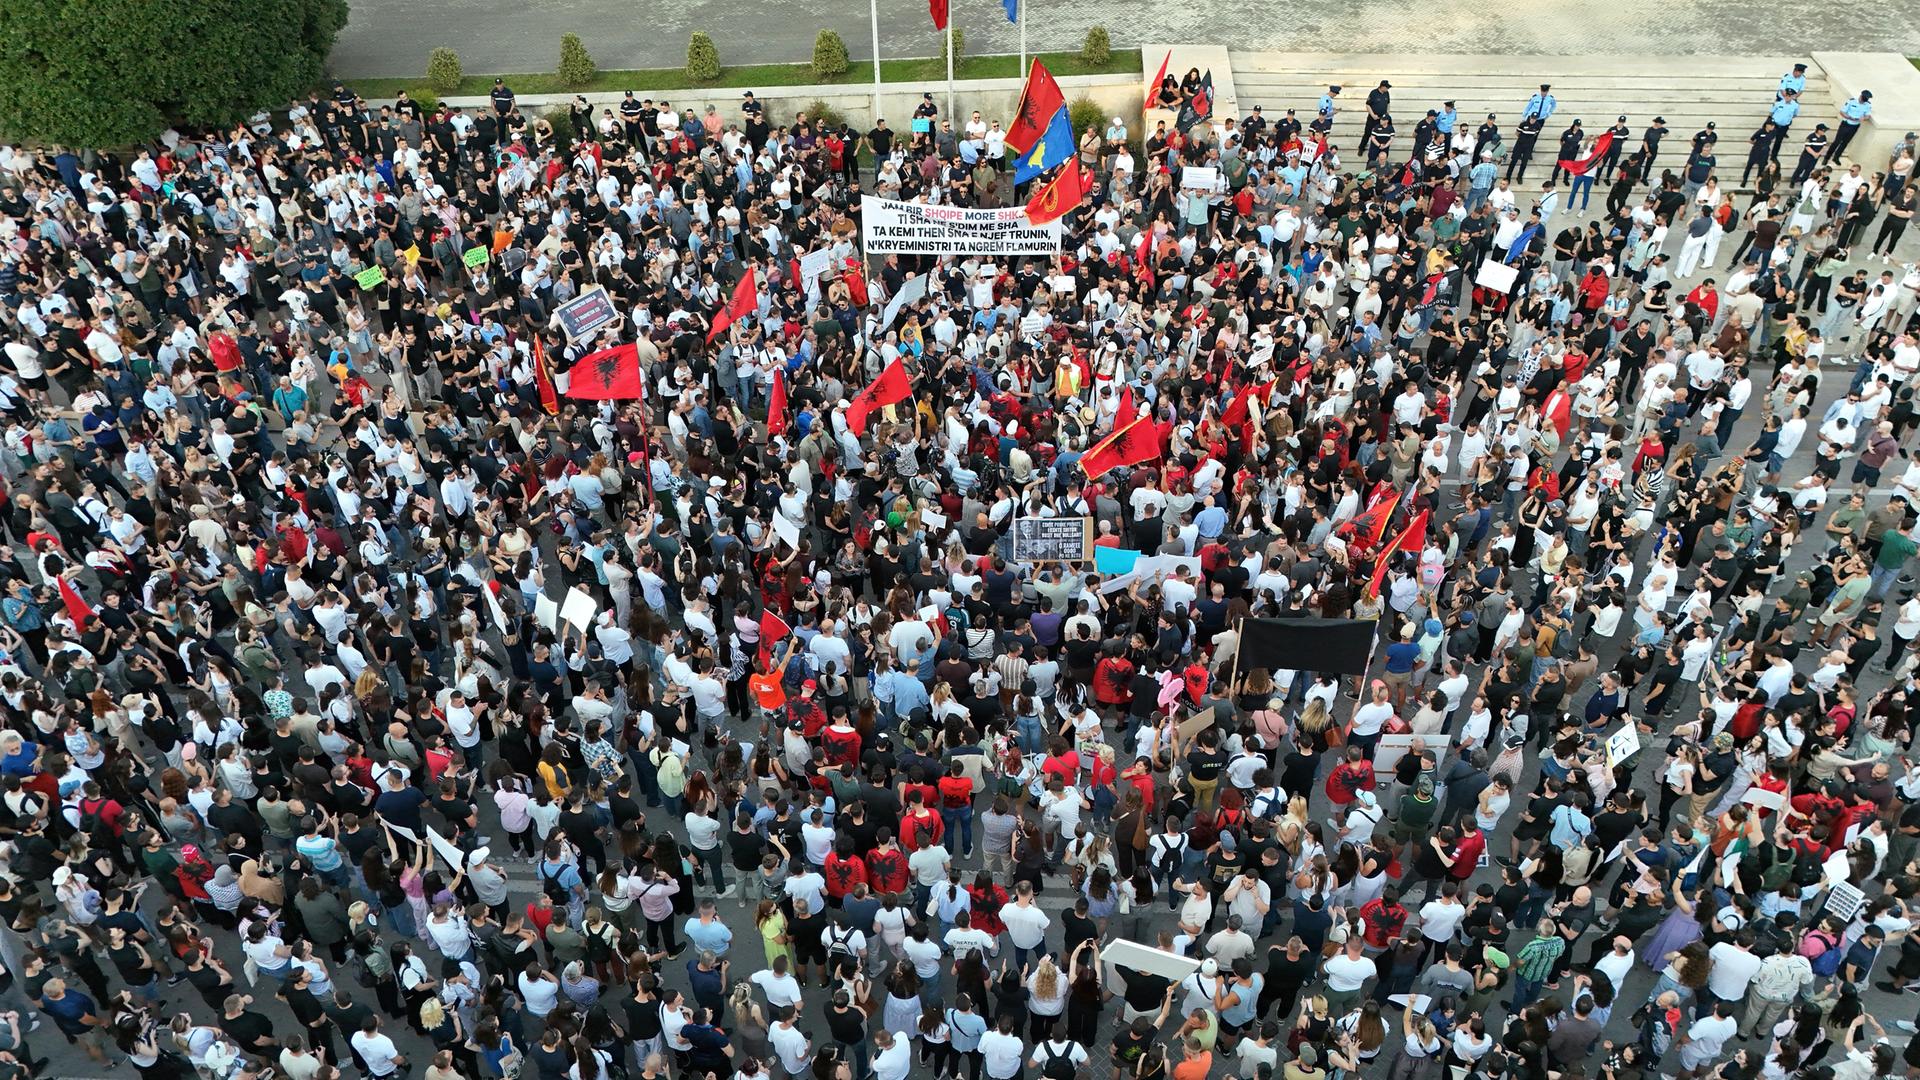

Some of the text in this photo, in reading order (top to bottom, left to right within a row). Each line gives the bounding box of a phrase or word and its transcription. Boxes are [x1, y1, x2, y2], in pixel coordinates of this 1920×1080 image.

[881, 202, 904, 211] JAM
[906, 205, 923, 215] BIR
[925, 208, 962, 220] SHQIPE
[965, 212, 995, 220] MORE
[898, 214, 907, 224] TI
[909, 214, 931, 224] SHA
[979, 223, 995, 231] ME
[997, 221, 1019, 230] SHA
[873, 226, 887, 236] TA
[889, 226, 914, 237] KEMI
[917, 227, 945, 238] THEN
[980, 231, 1007, 240] NJEF
[1008, 229, 1051, 240] TRUNIN,
[867, 239, 1057, 252] N'KRYEMINISTRI TA NGREM FLAMURIN
